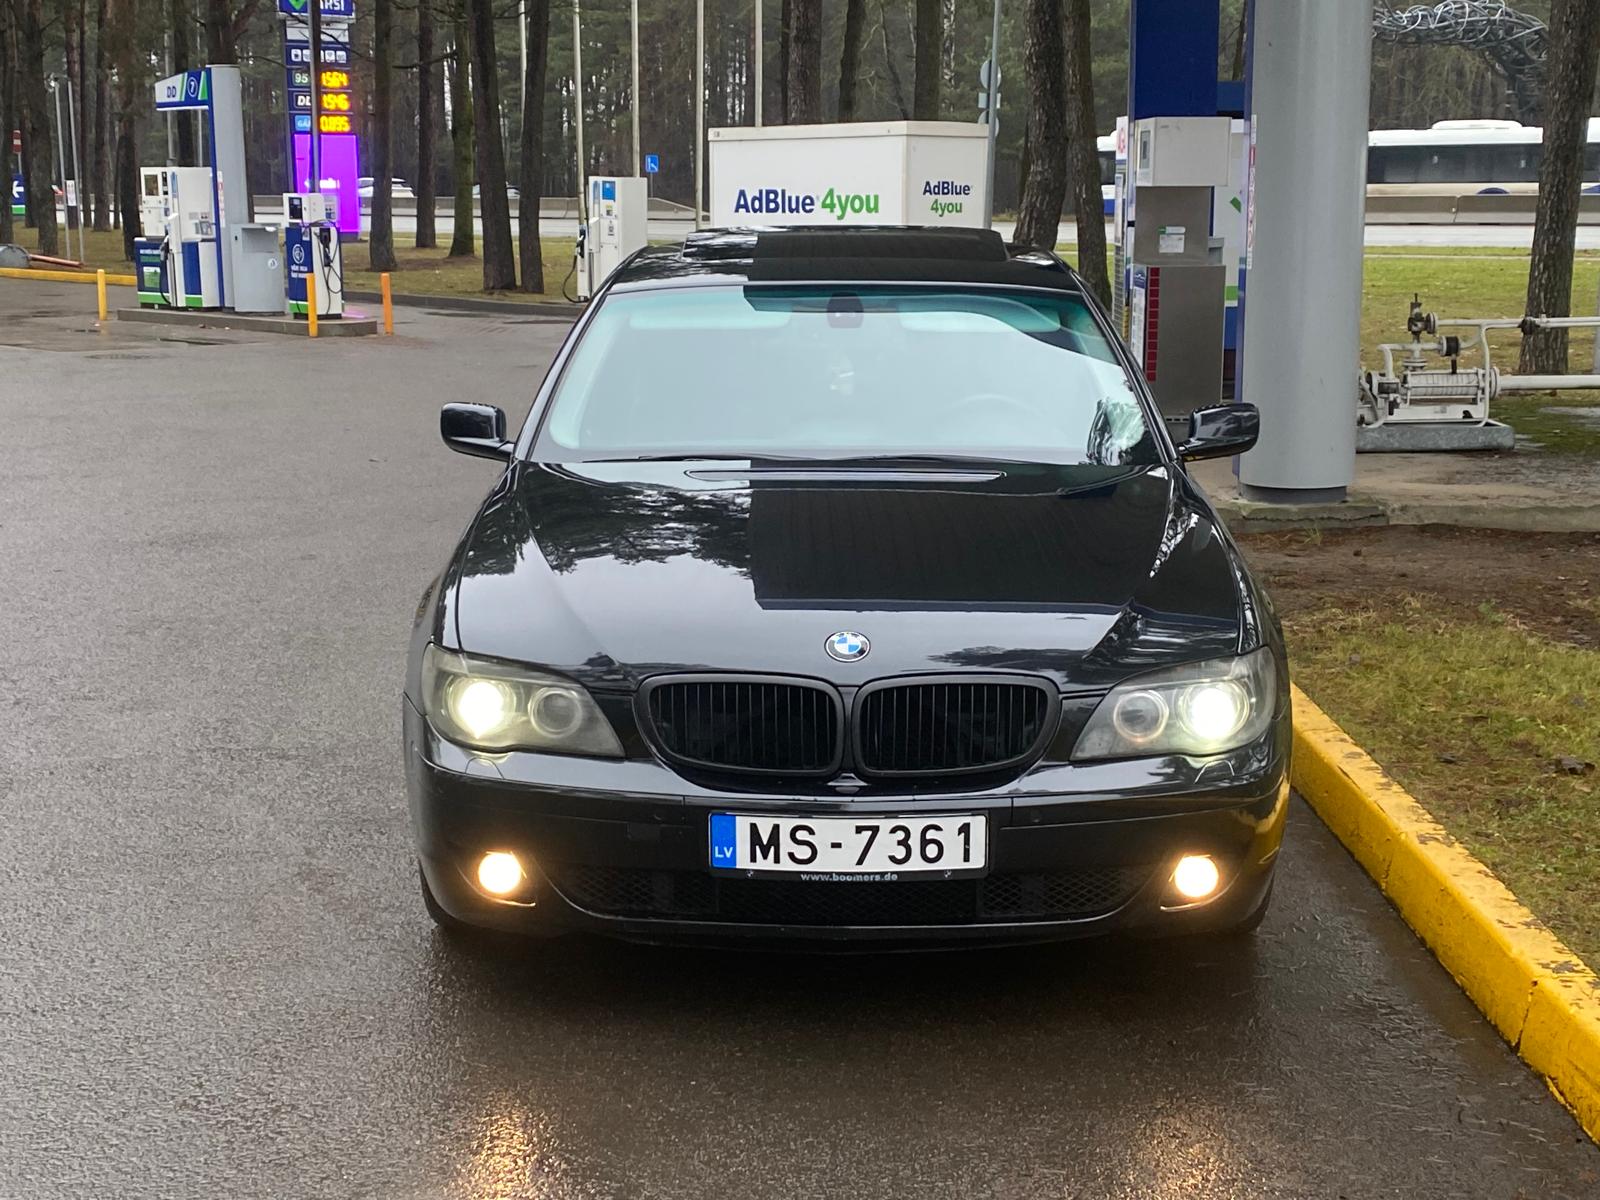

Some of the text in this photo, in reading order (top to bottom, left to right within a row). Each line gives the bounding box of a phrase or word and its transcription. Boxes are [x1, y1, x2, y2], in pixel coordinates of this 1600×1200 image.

[295, 73, 309, 83] 95
[167, 86, 177, 98] DD
[922, 180, 971, 195] AdBlue
[734, 188, 879, 220] AdBlue 4you
[930, 198, 963, 217] 4you
[749, 821, 971, 866] MS-7361
[714, 846, 734, 858] LV
[800, 872, 898, 881] www.boomers.de
